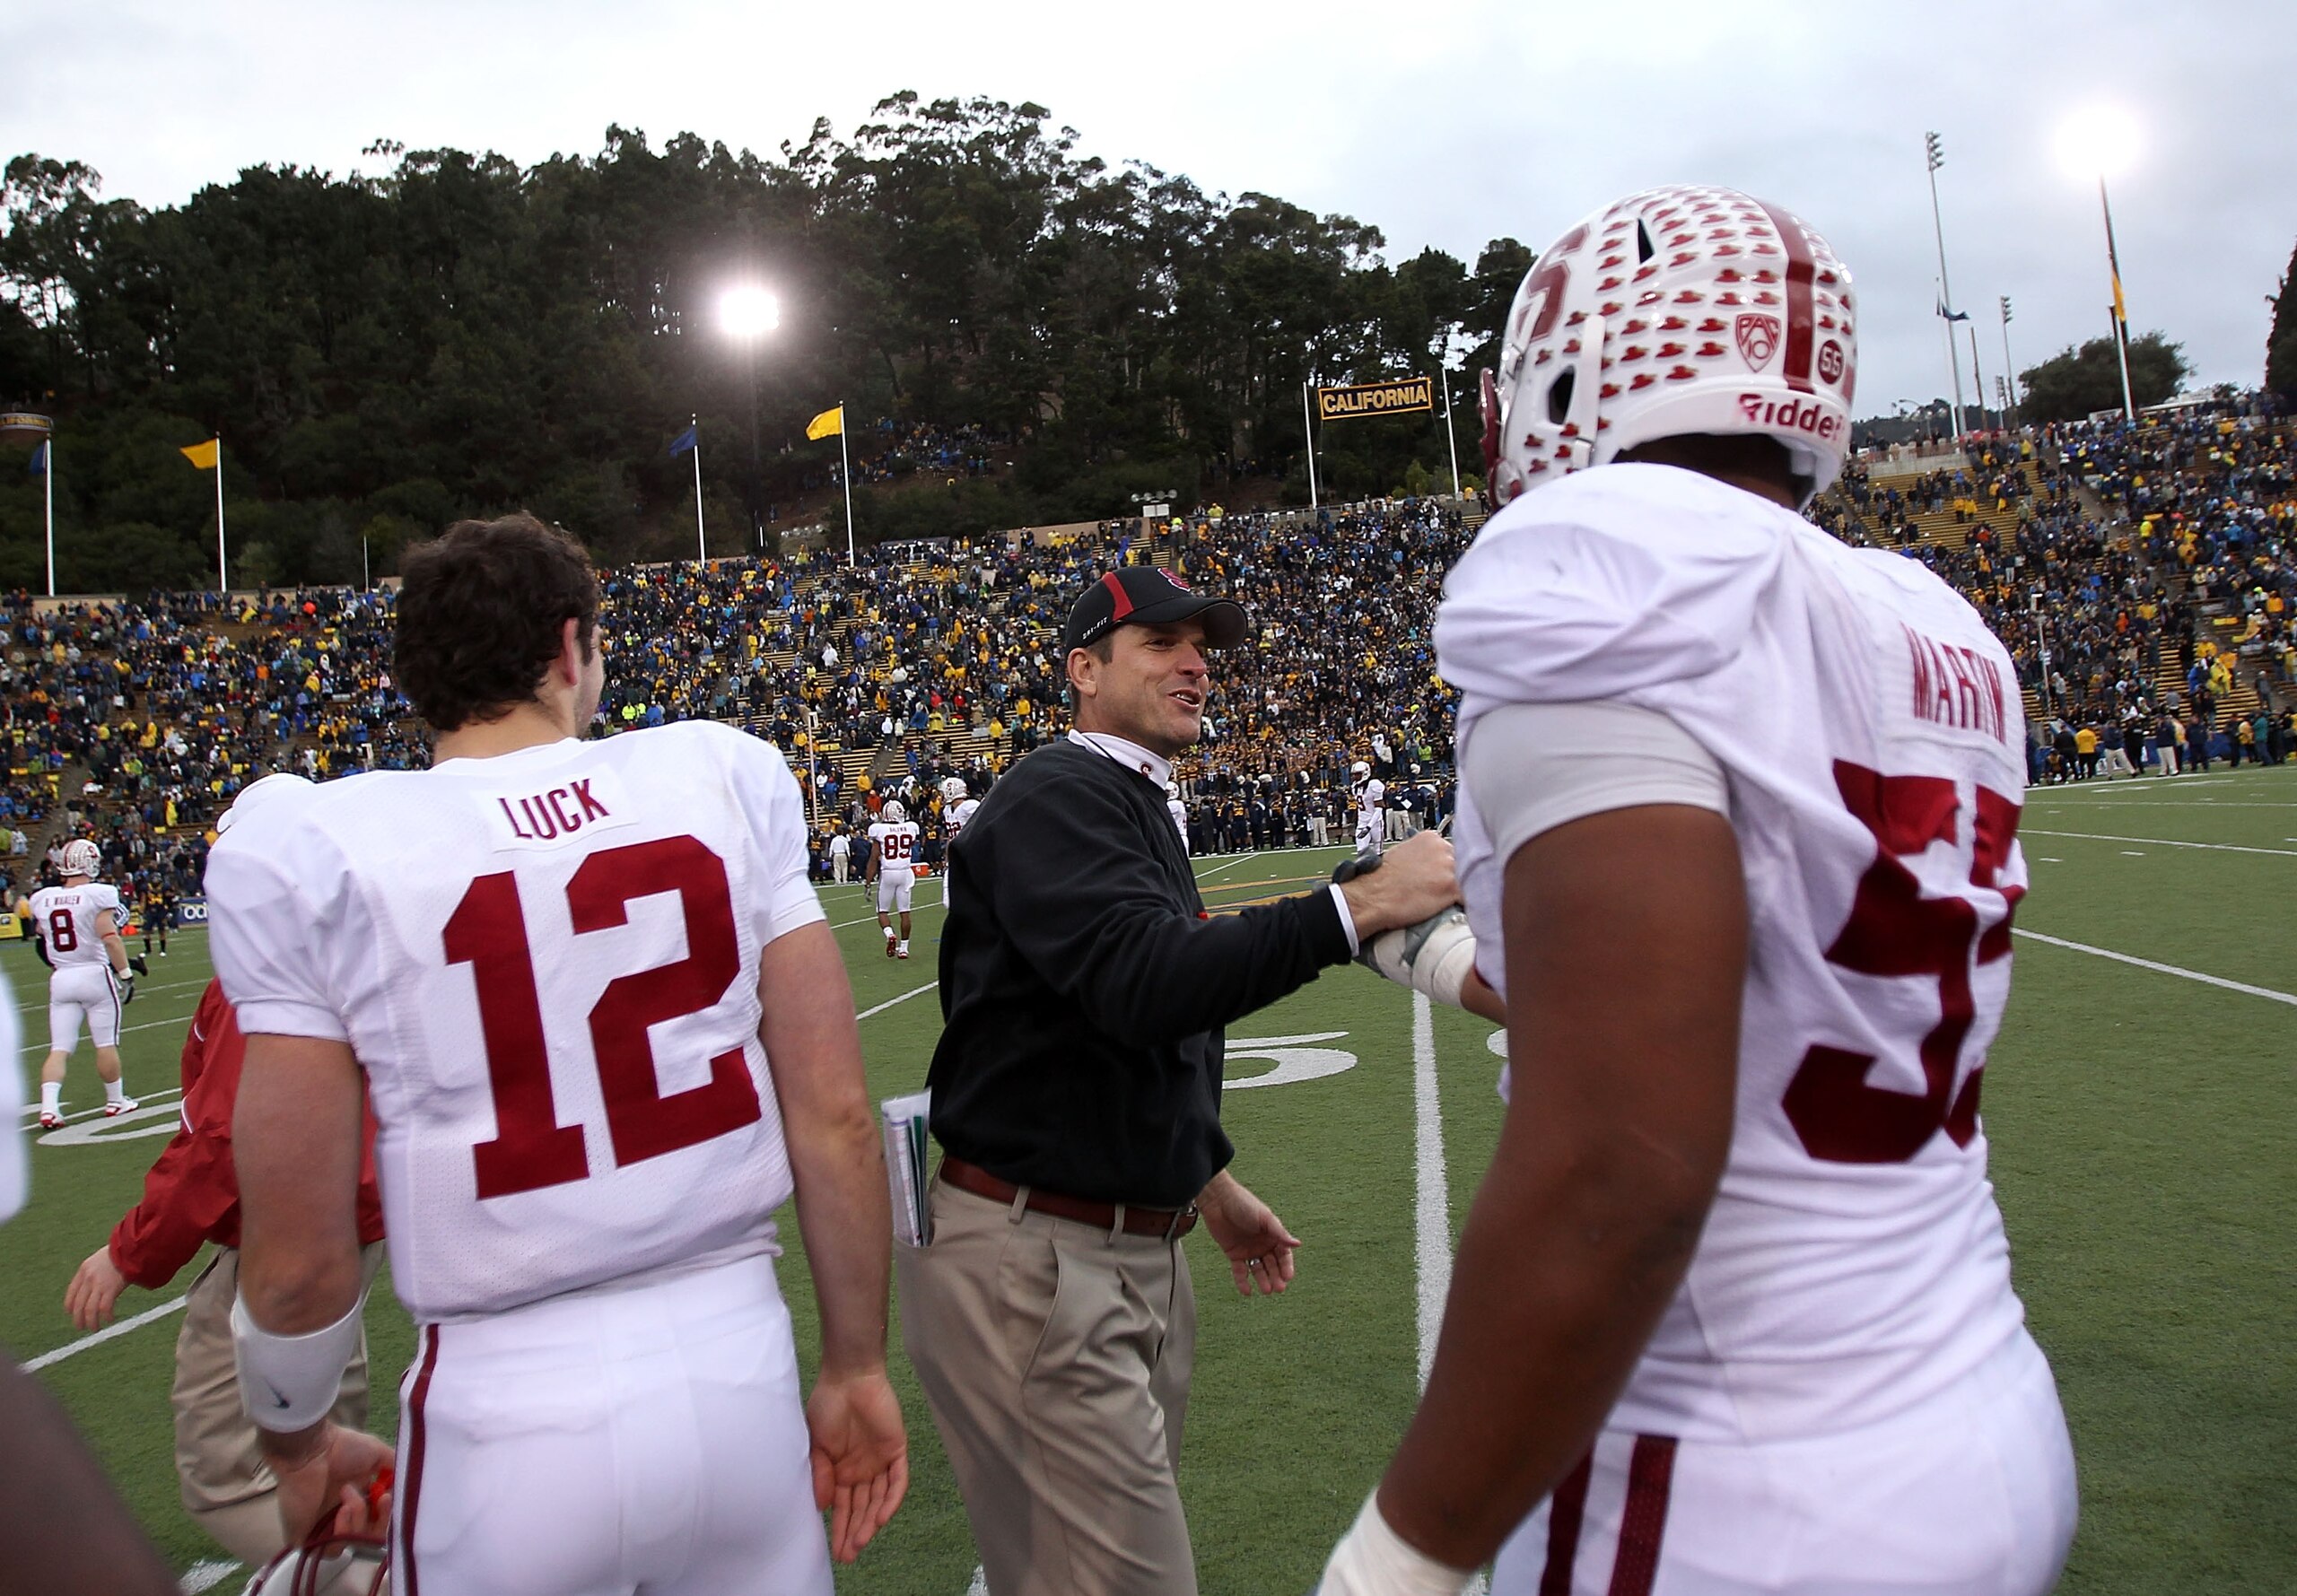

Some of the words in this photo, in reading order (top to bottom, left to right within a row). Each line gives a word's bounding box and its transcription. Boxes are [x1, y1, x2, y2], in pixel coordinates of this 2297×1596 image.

[1738, 316, 1780, 351] PAC
[1821, 345, 1841, 377] 55
[1323, 385, 1428, 414] CALIFORNIA
[1082, 616, 1108, 640] DRI-FIT
[1899, 620, 2007, 747] MARTIN
[497, 778, 610, 841] LUCK
[884, 833, 913, 859] 89
[49, 909, 79, 953] 8
[441, 834, 762, 1200] 12
